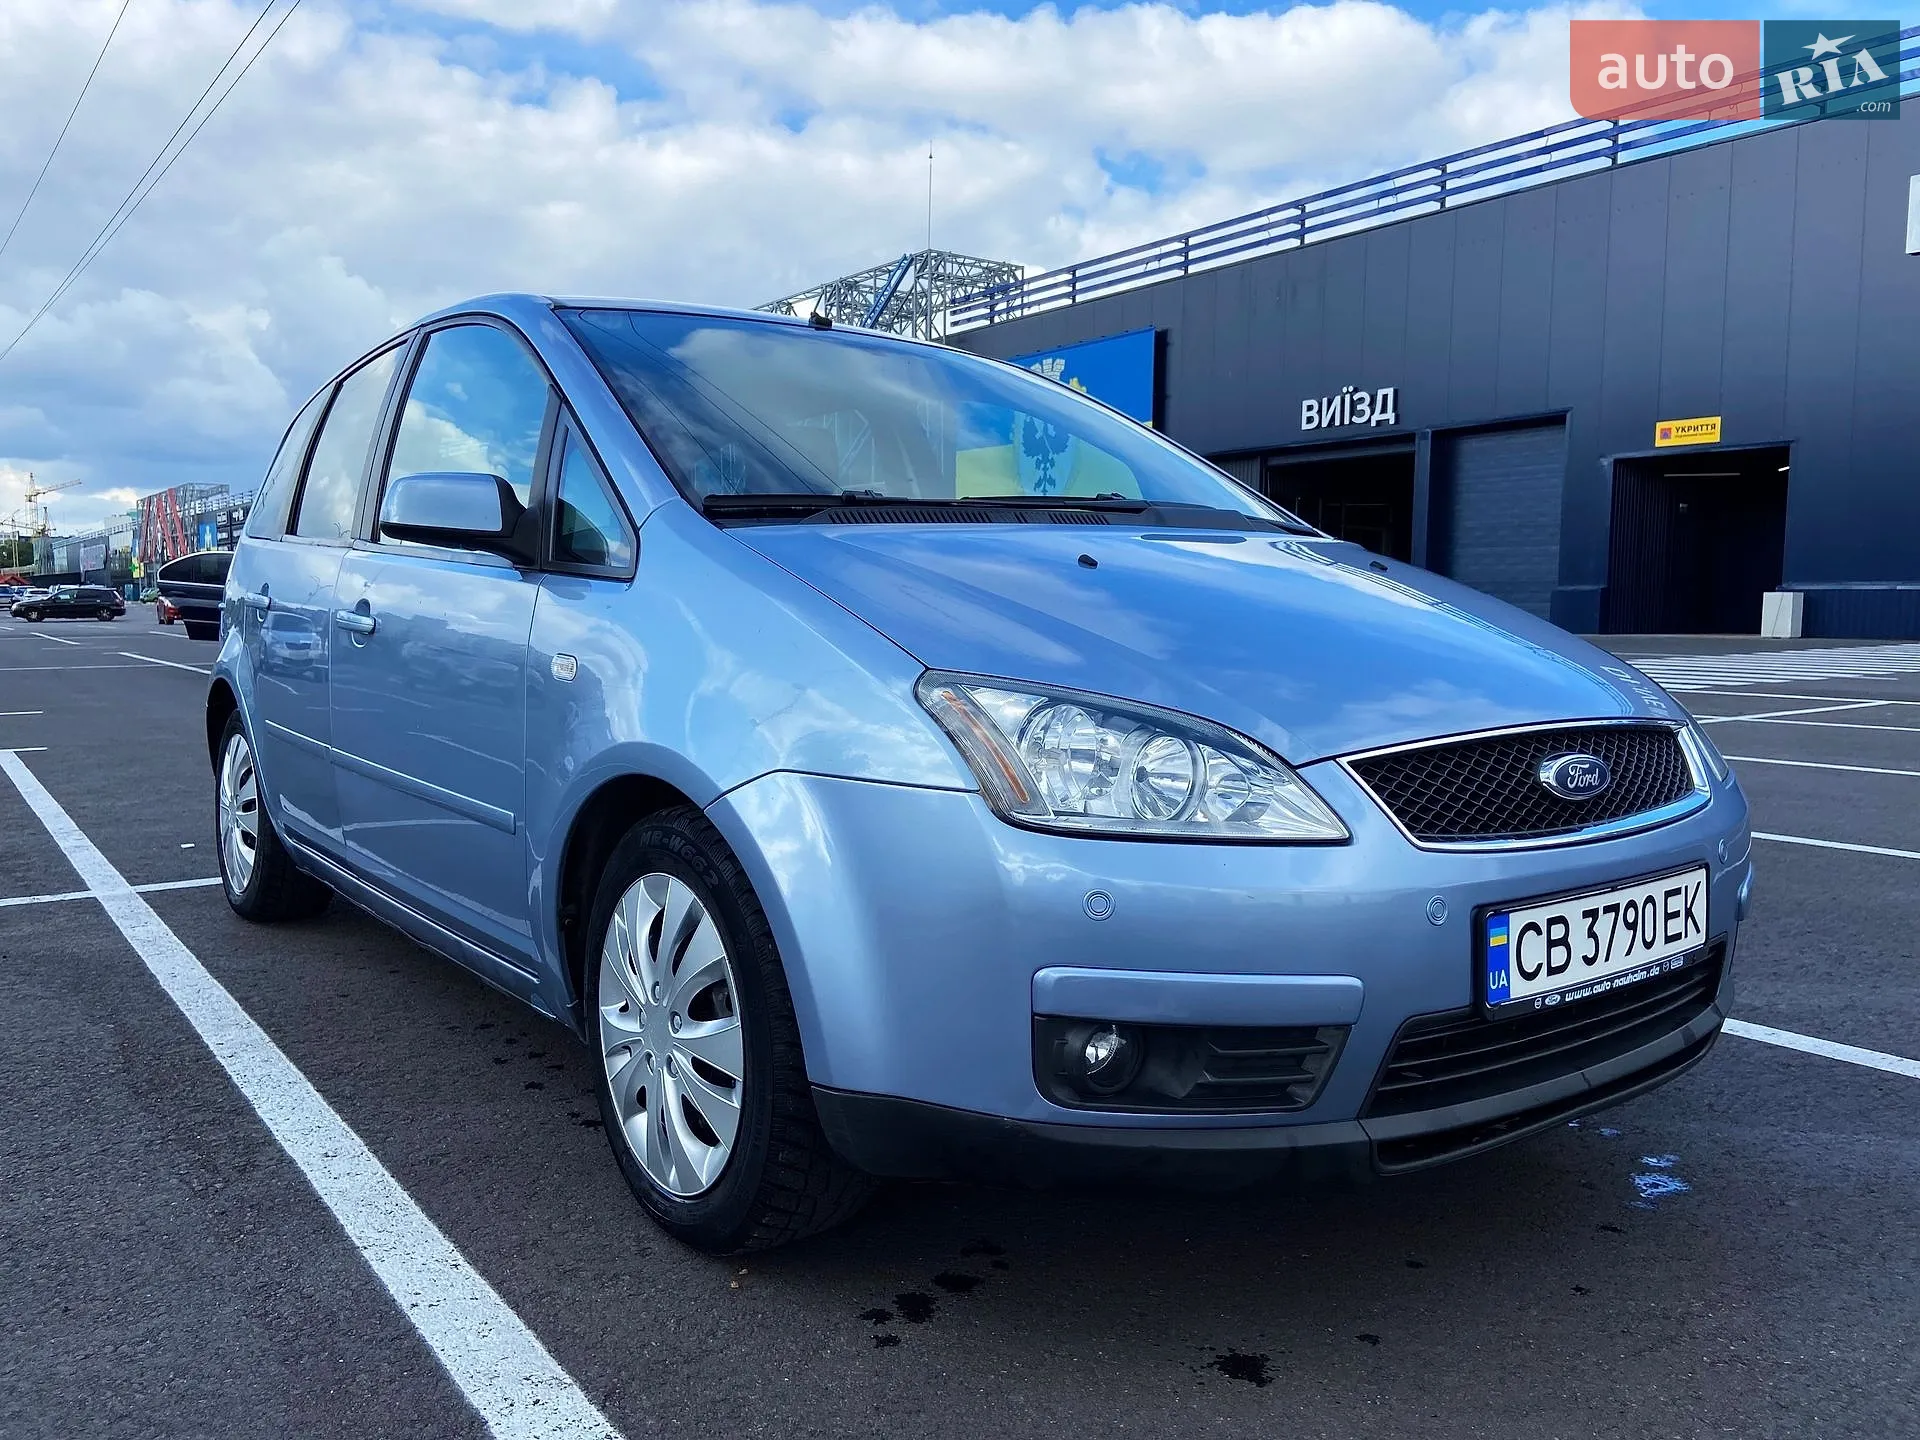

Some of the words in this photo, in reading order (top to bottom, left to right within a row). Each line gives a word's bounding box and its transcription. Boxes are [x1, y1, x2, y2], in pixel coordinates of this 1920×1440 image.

[1301, 385, 1396, 431] ВИЇЗД
[1675, 423, 1716, 433] УКРИТТЯ
[1567, 763, 1600, 789] Ford
[1515, 914, 1572, 982] CB
[1581, 894, 1657, 967] 3790
[1663, 880, 1702, 945] EK
[1489, 969, 1509, 990] UA
